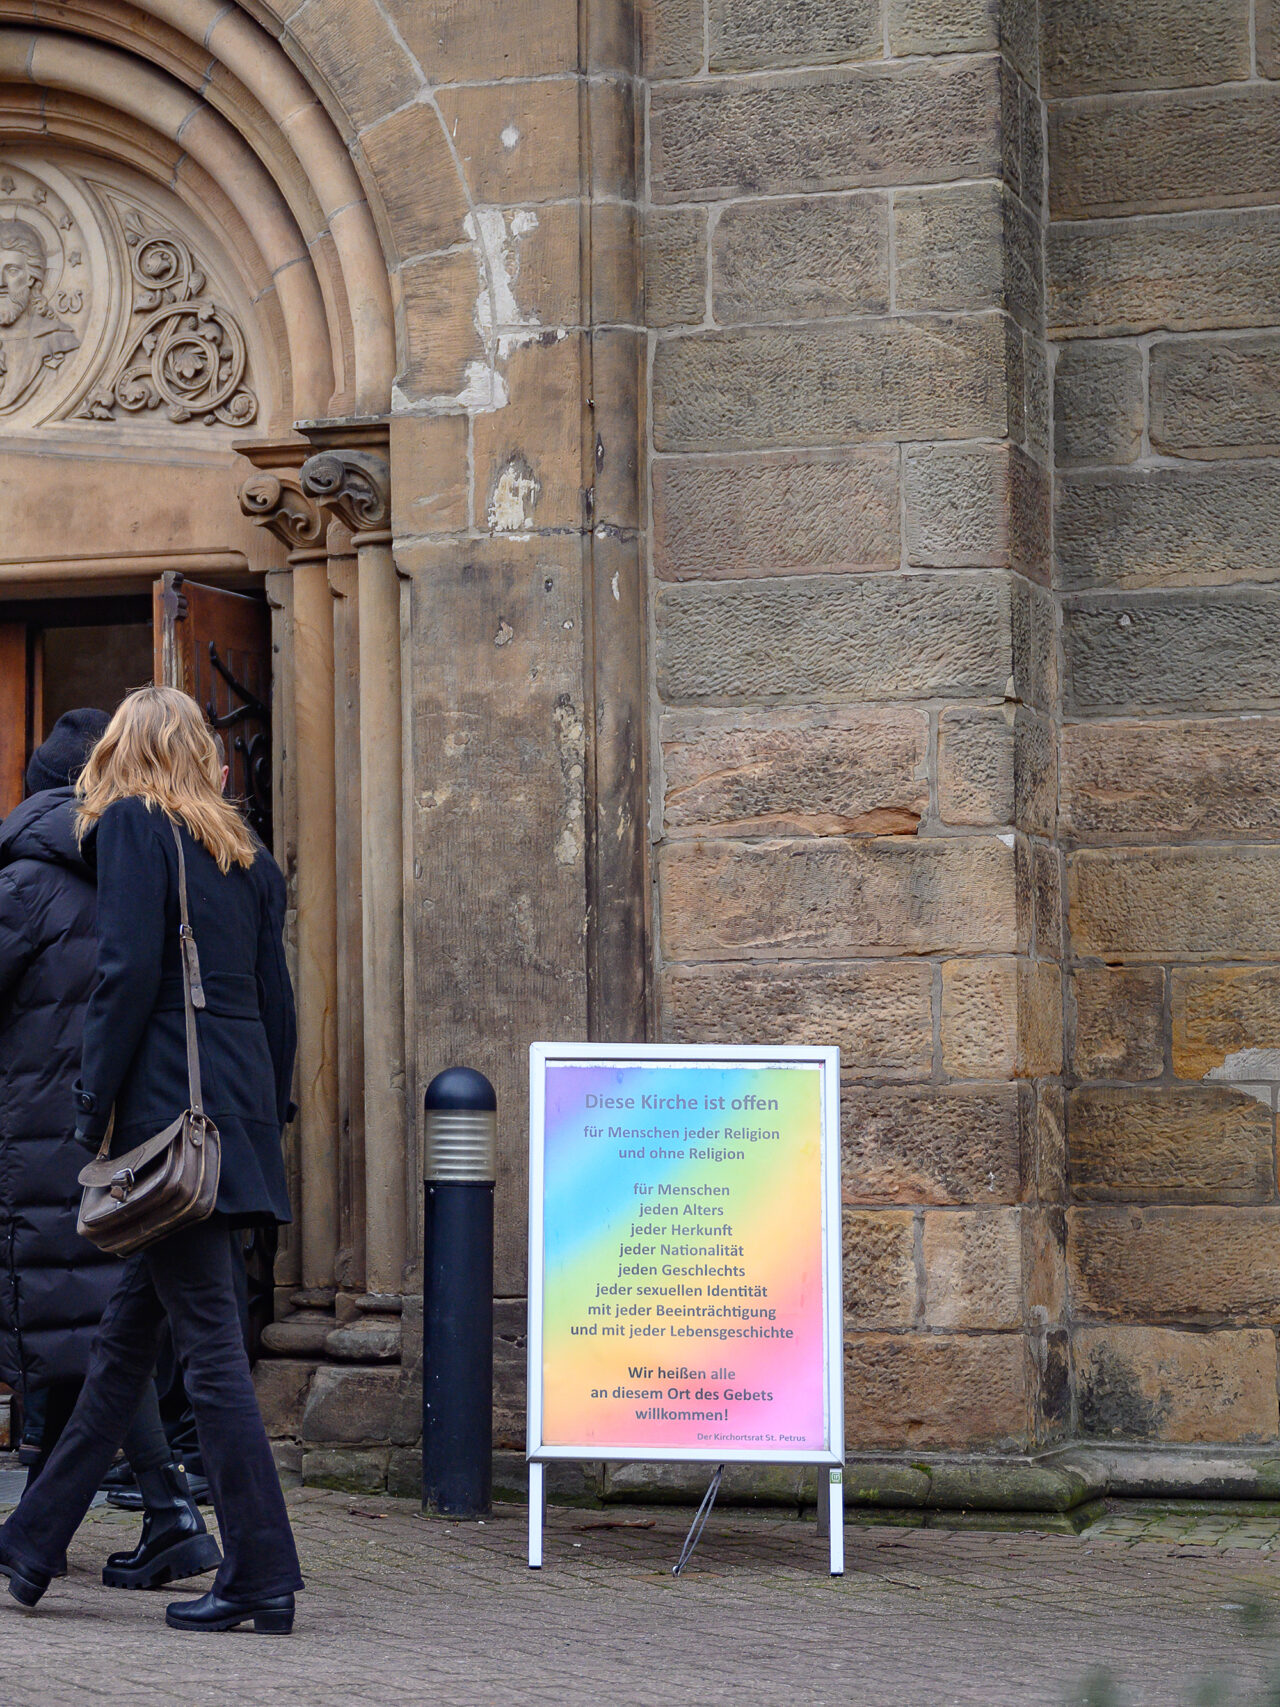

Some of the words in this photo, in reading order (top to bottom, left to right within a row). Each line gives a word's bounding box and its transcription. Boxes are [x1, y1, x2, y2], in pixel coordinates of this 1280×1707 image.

[585, 1094, 635, 1109] Diese
[641, 1094, 698, 1110] Kirche
[704, 1095, 725, 1110] ist
[731, 1095, 779, 1111] offen
[584, 1126, 604, 1139] für
[608, 1127, 680, 1139] Menschen
[682, 1127, 720, 1143] jeder
[724, 1128, 780, 1143] Religion
[619, 1146, 645, 1159] und
[649, 1147, 685, 1159] ohne
[689, 1147, 745, 1162] Religion
[633, 1183, 654, 1195] für
[658, 1183, 730, 1196] Menschen
[638, 1203, 679, 1218] jeden
[683, 1204, 724, 1216] Alters
[629, 1223, 667, 1238] jeder
[671, 1224, 733, 1236] Herkunft
[618, 1243, 656, 1258] jeder
[660, 1244, 744, 1257] Nationalität
[617, 1264, 657, 1279] jeden
[661, 1264, 746, 1277] Geschlechts
[595, 1283, 632, 1298] jeder
[636, 1284, 703, 1297] sexuellen
[707, 1285, 768, 1297] Identität
[588, 1304, 611, 1316] mit
[614, 1304, 652, 1319] jeder
[656, 1305, 776, 1321] Beeinträchtigung
[570, 1324, 597, 1336] und
[601, 1324, 625, 1337] mit
[628, 1325, 666, 1339] jeder
[670, 1325, 794, 1341] Lebensgeschichte
[628, 1366, 653, 1379] Wir
[657, 1367, 707, 1380] heißen
[711, 1368, 736, 1380] alle
[590, 1388, 608, 1399] an
[612, 1387, 663, 1400] diesem
[667, 1388, 691, 1400] Ort
[695, 1389, 720, 1401] des
[723, 1390, 773, 1402] Gebets
[635, 1408, 729, 1421] willkommen!
[697, 1433, 713, 1441] Der
[714, 1433, 763, 1442] Kirchortsrat
[765, 1434, 777, 1442] St.
[779, 1434, 806, 1442] Petrus
